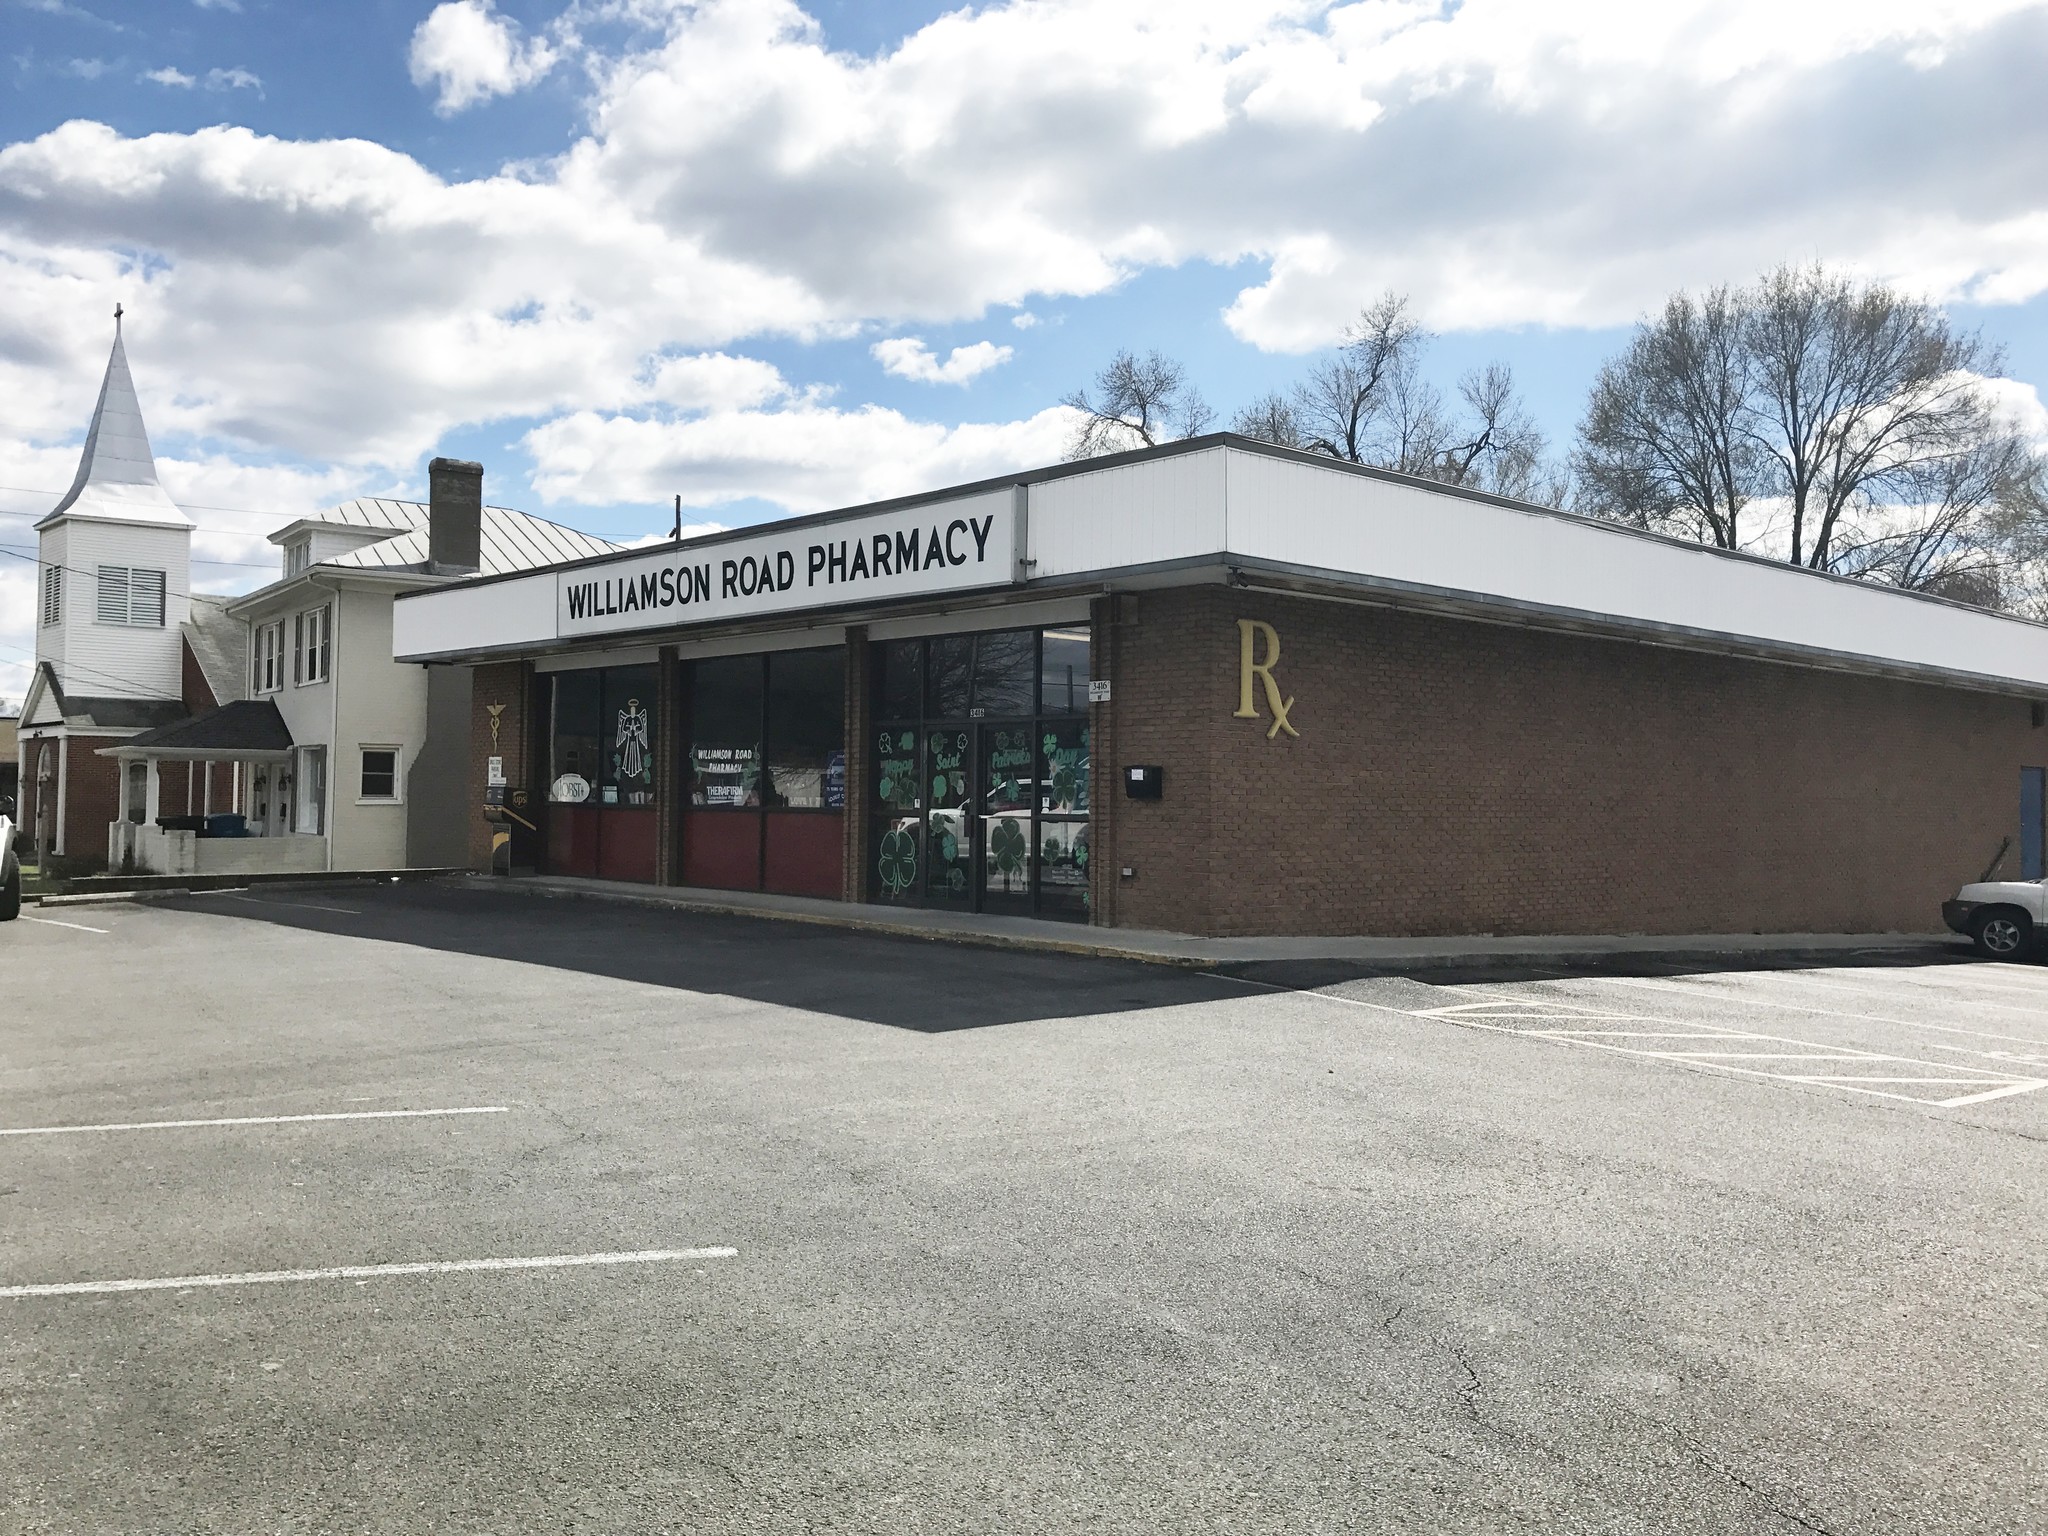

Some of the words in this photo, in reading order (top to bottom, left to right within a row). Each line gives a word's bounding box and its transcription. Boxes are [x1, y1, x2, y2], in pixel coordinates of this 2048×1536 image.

[568, 563, 710, 619] WILLIAMSON
[722, 550, 795, 599] ROAD
[808, 514, 994, 587] PHARMACY
[1233, 618, 1300, 740] Rx
[1093, 682, 1107, 690] 3416
[970, 709, 984, 717] 3416
[698, 749, 732, 760] WILLIAMSON
[735, 749, 752, 760] ROAD
[936, 751, 960, 771] Saint
[1055, 748, 1078, 766] Day
[708, 762, 742, 773] PHARMACY
[706, 785, 744, 796] THERAFIRM
[514, 796, 526, 806] ups
